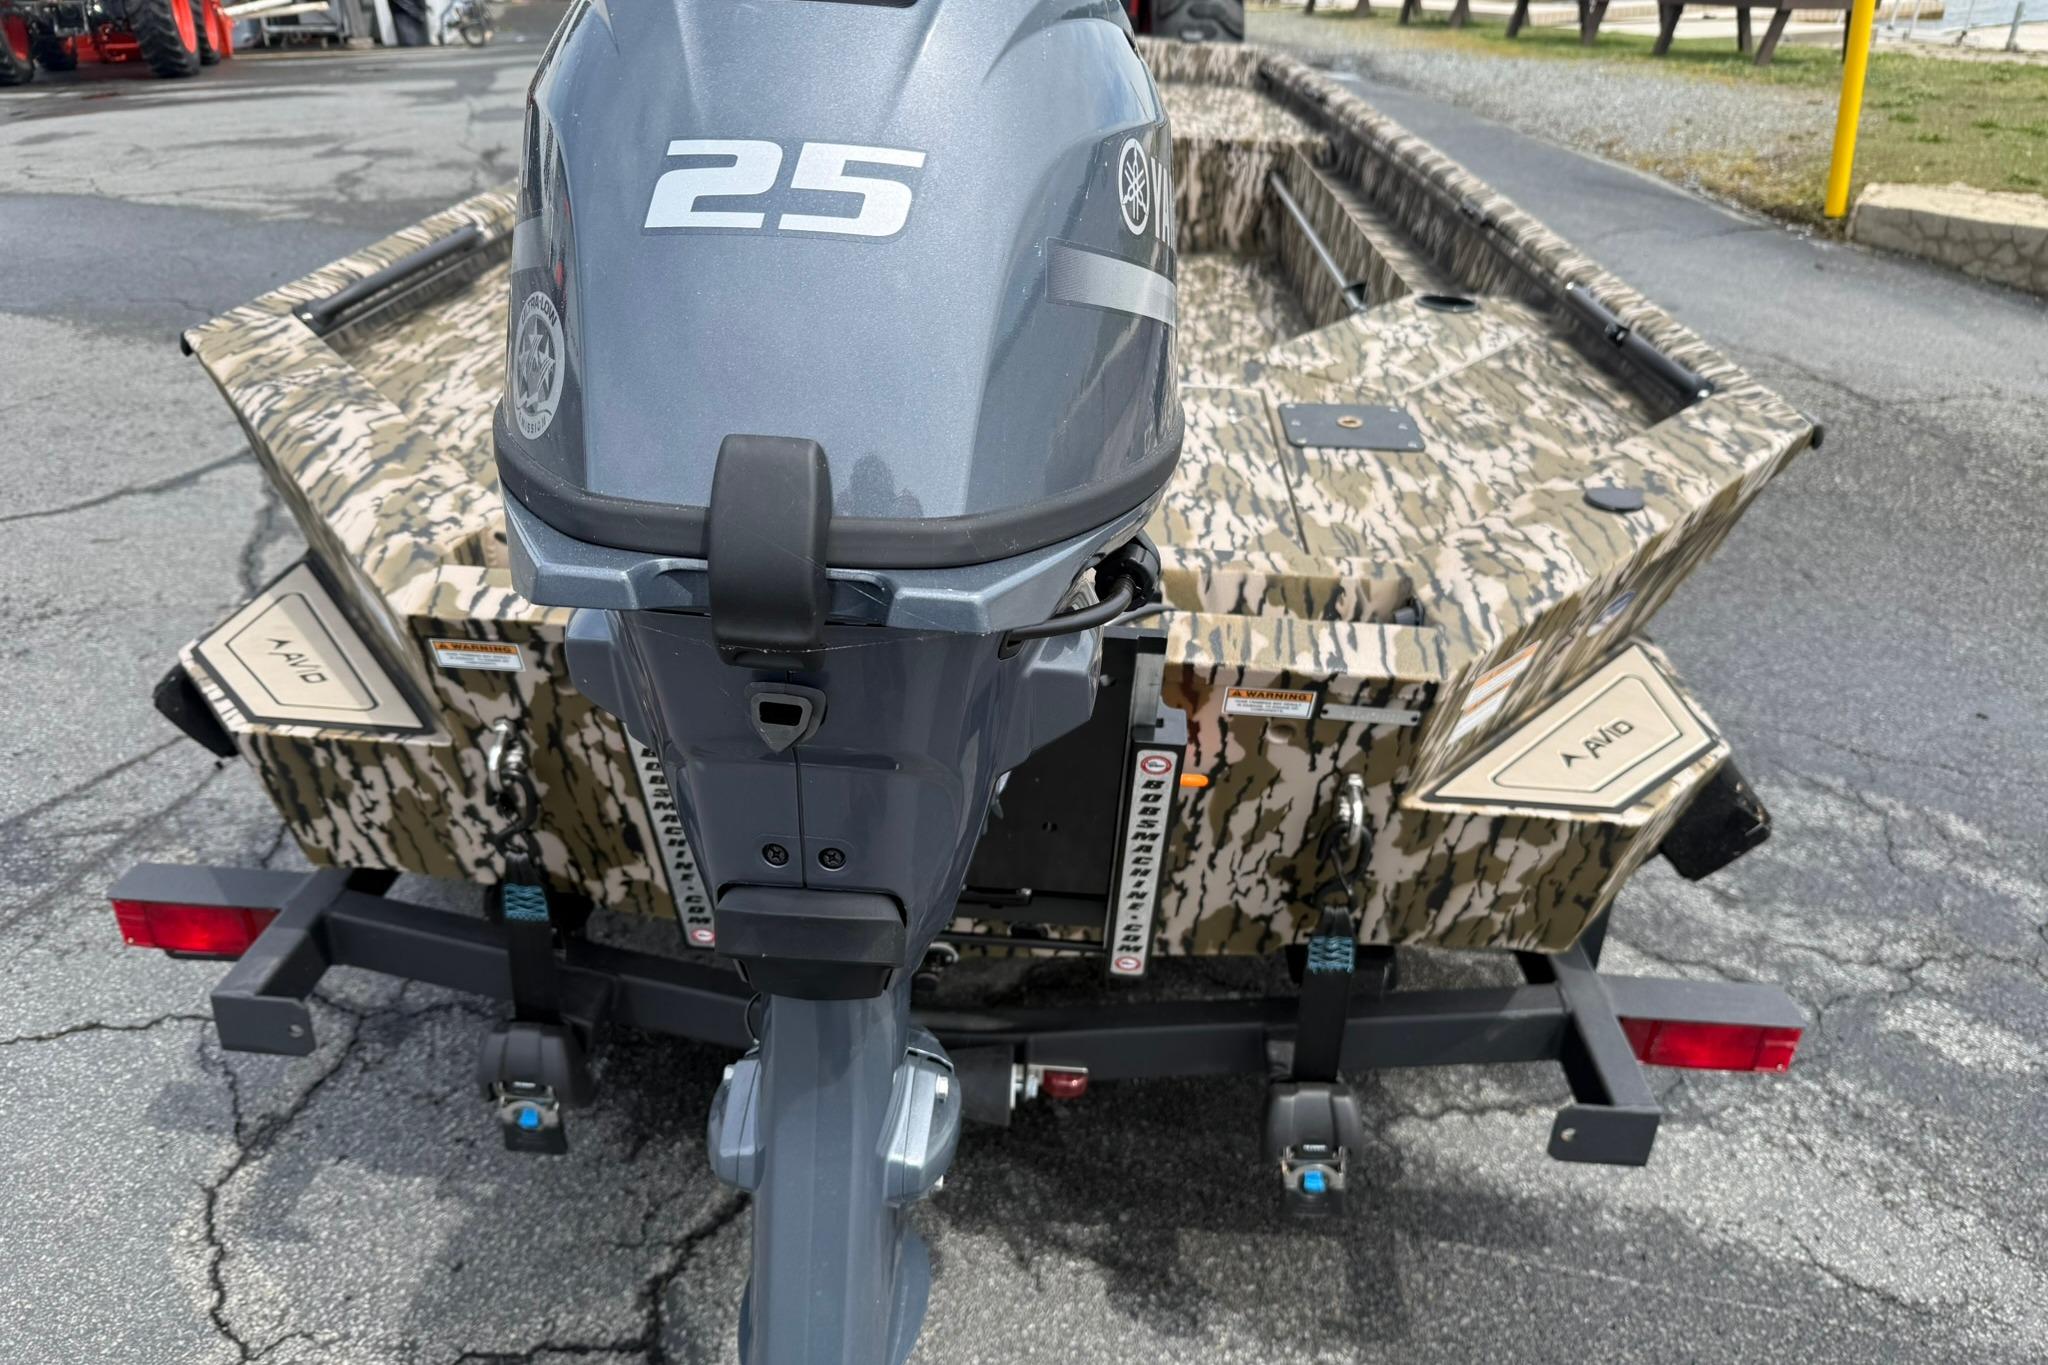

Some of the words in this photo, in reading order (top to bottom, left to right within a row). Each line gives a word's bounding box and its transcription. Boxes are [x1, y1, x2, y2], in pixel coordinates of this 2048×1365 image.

[644, 139, 926, 237] 25
[267, 652, 328, 684] AVID
[1246, 690, 1307, 701] WARNING
[1584, 720, 1634, 759] AVID
